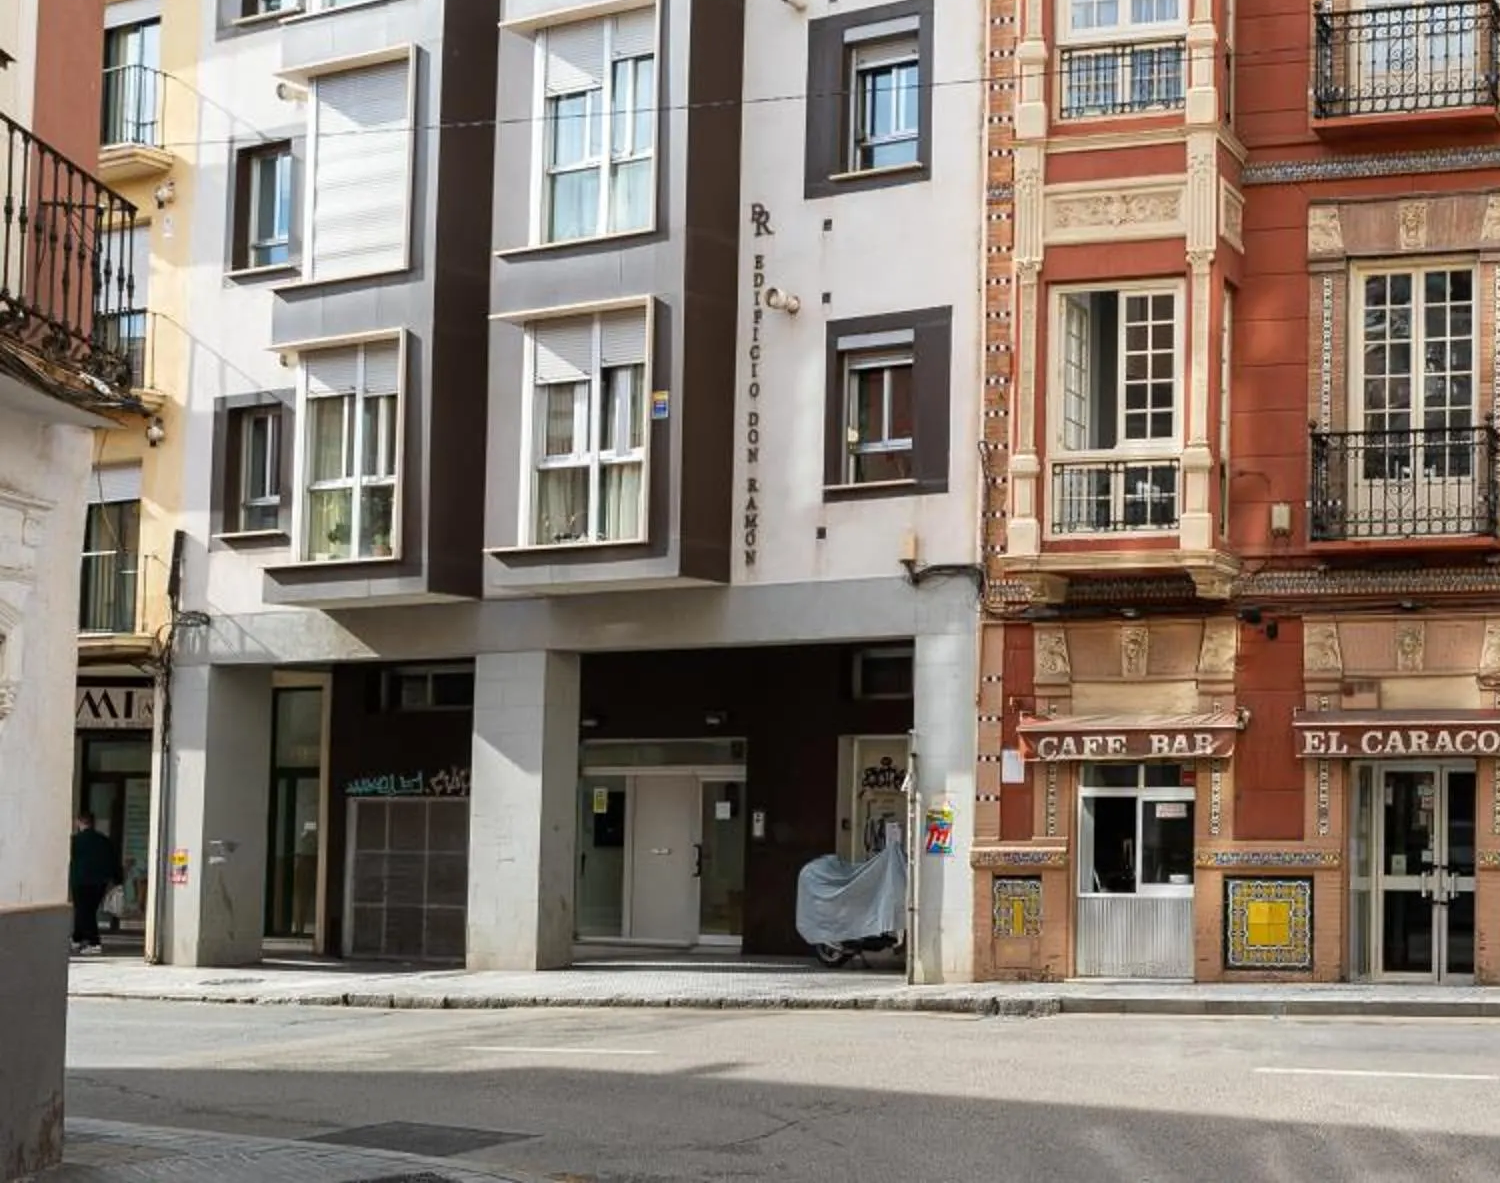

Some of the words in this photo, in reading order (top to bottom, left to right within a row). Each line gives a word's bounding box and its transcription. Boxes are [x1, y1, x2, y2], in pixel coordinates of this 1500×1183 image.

[749, 254, 765, 398] EDIFICIO
[747, 411, 759, 463] DON
[1037, 735, 1128, 760] CAFE
[1302, 730, 1347, 754] EL
